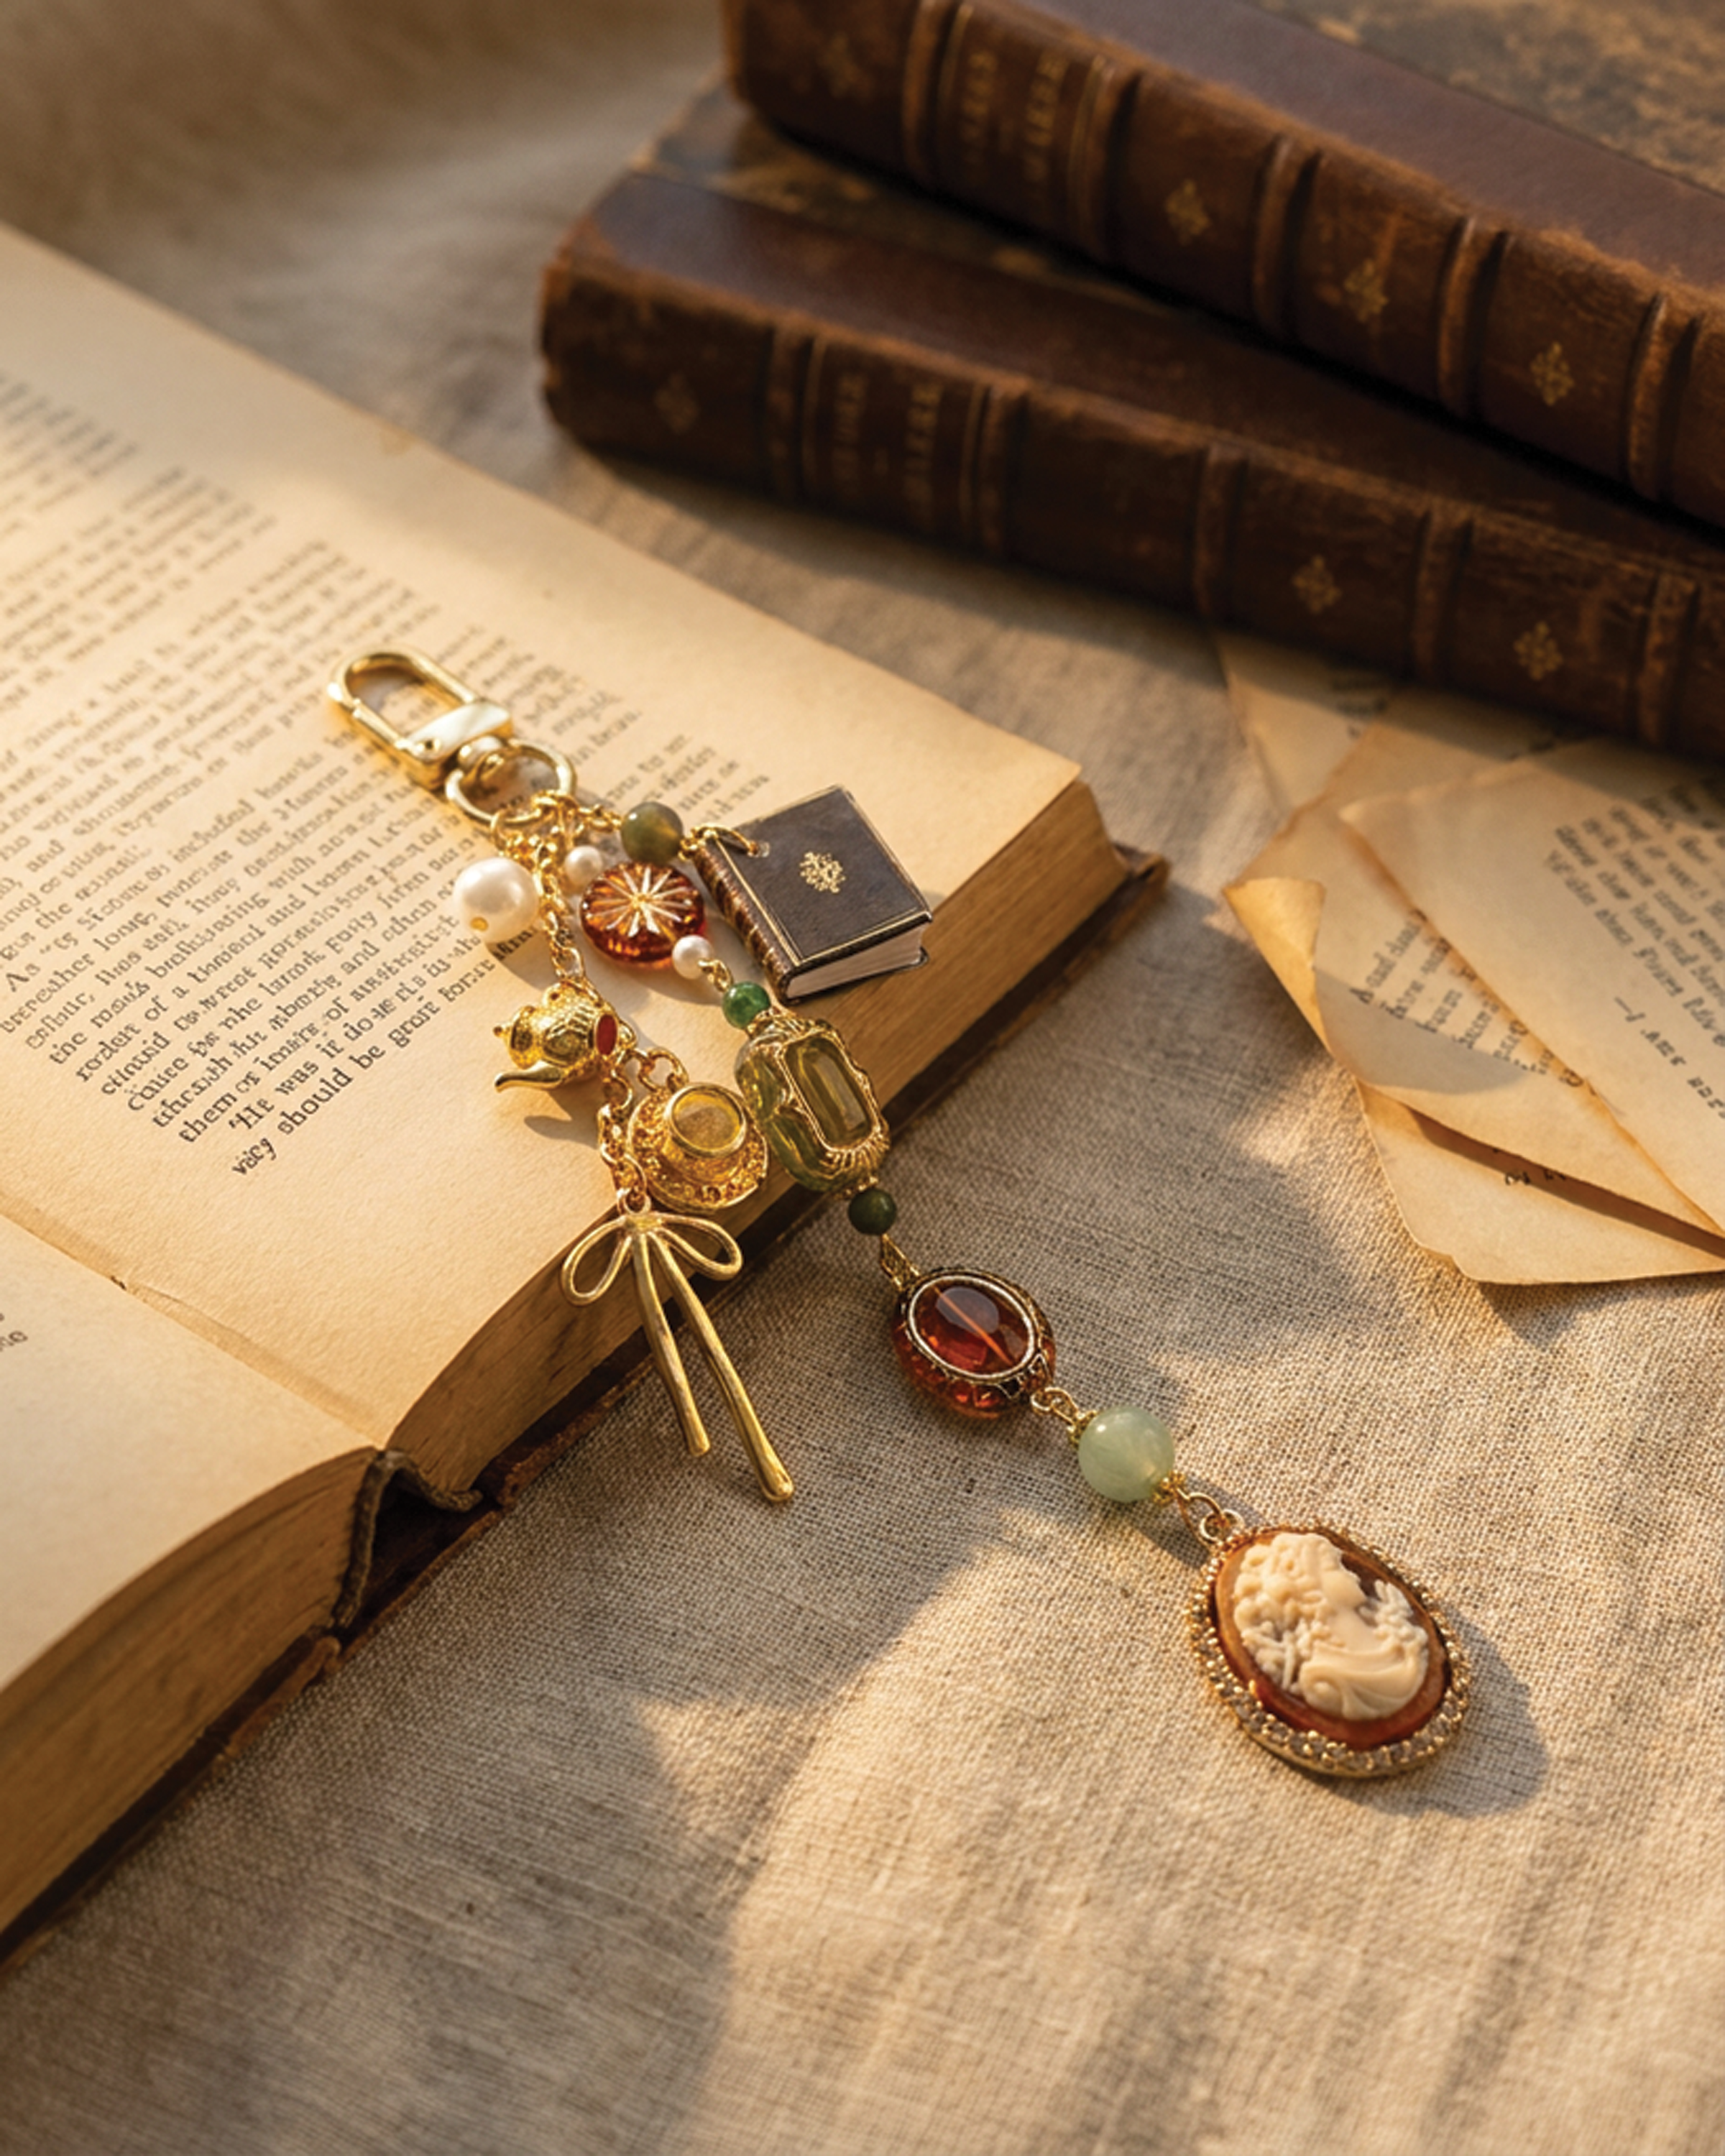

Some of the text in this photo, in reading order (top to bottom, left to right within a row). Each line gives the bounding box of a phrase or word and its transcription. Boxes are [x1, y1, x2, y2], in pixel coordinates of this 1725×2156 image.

[340, 939, 381, 975] and
[144, 995, 169, 1021] of
[277, 1067, 354, 1135] should
[348, 1045, 386, 1070] be
[178, 1092, 238, 1143] them
